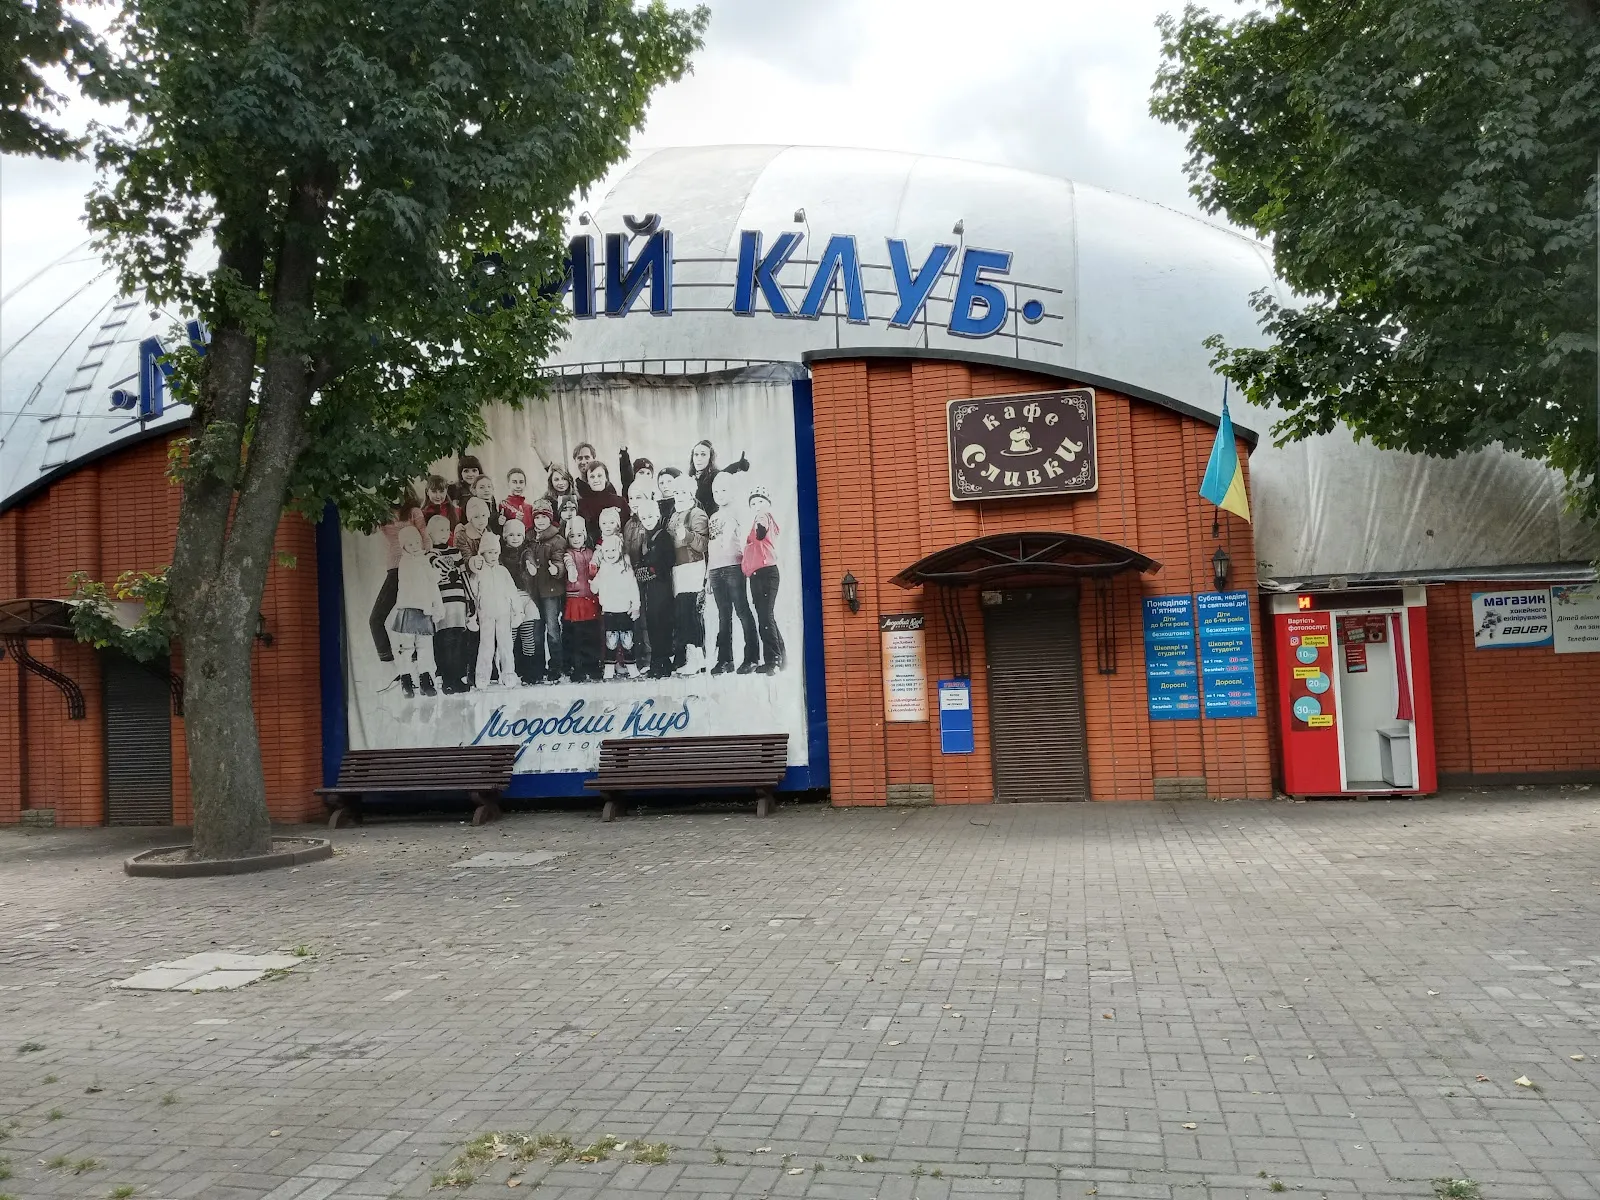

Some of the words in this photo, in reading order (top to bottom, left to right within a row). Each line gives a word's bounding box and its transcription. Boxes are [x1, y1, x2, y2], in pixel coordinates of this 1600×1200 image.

[982, 402, 1059, 432] кафе
[962, 437, 1084, 487] Сливки
[1146, 598, 1190, 608] Понеділок-
[1483, 594, 1546, 607] магазин
[1160, 682, 1186, 690] Дорослі
[1214, 678, 1242, 686] Дорослі
[1297, 706, 1308, 714] 30
[621, 695, 699, 738] Клуб
